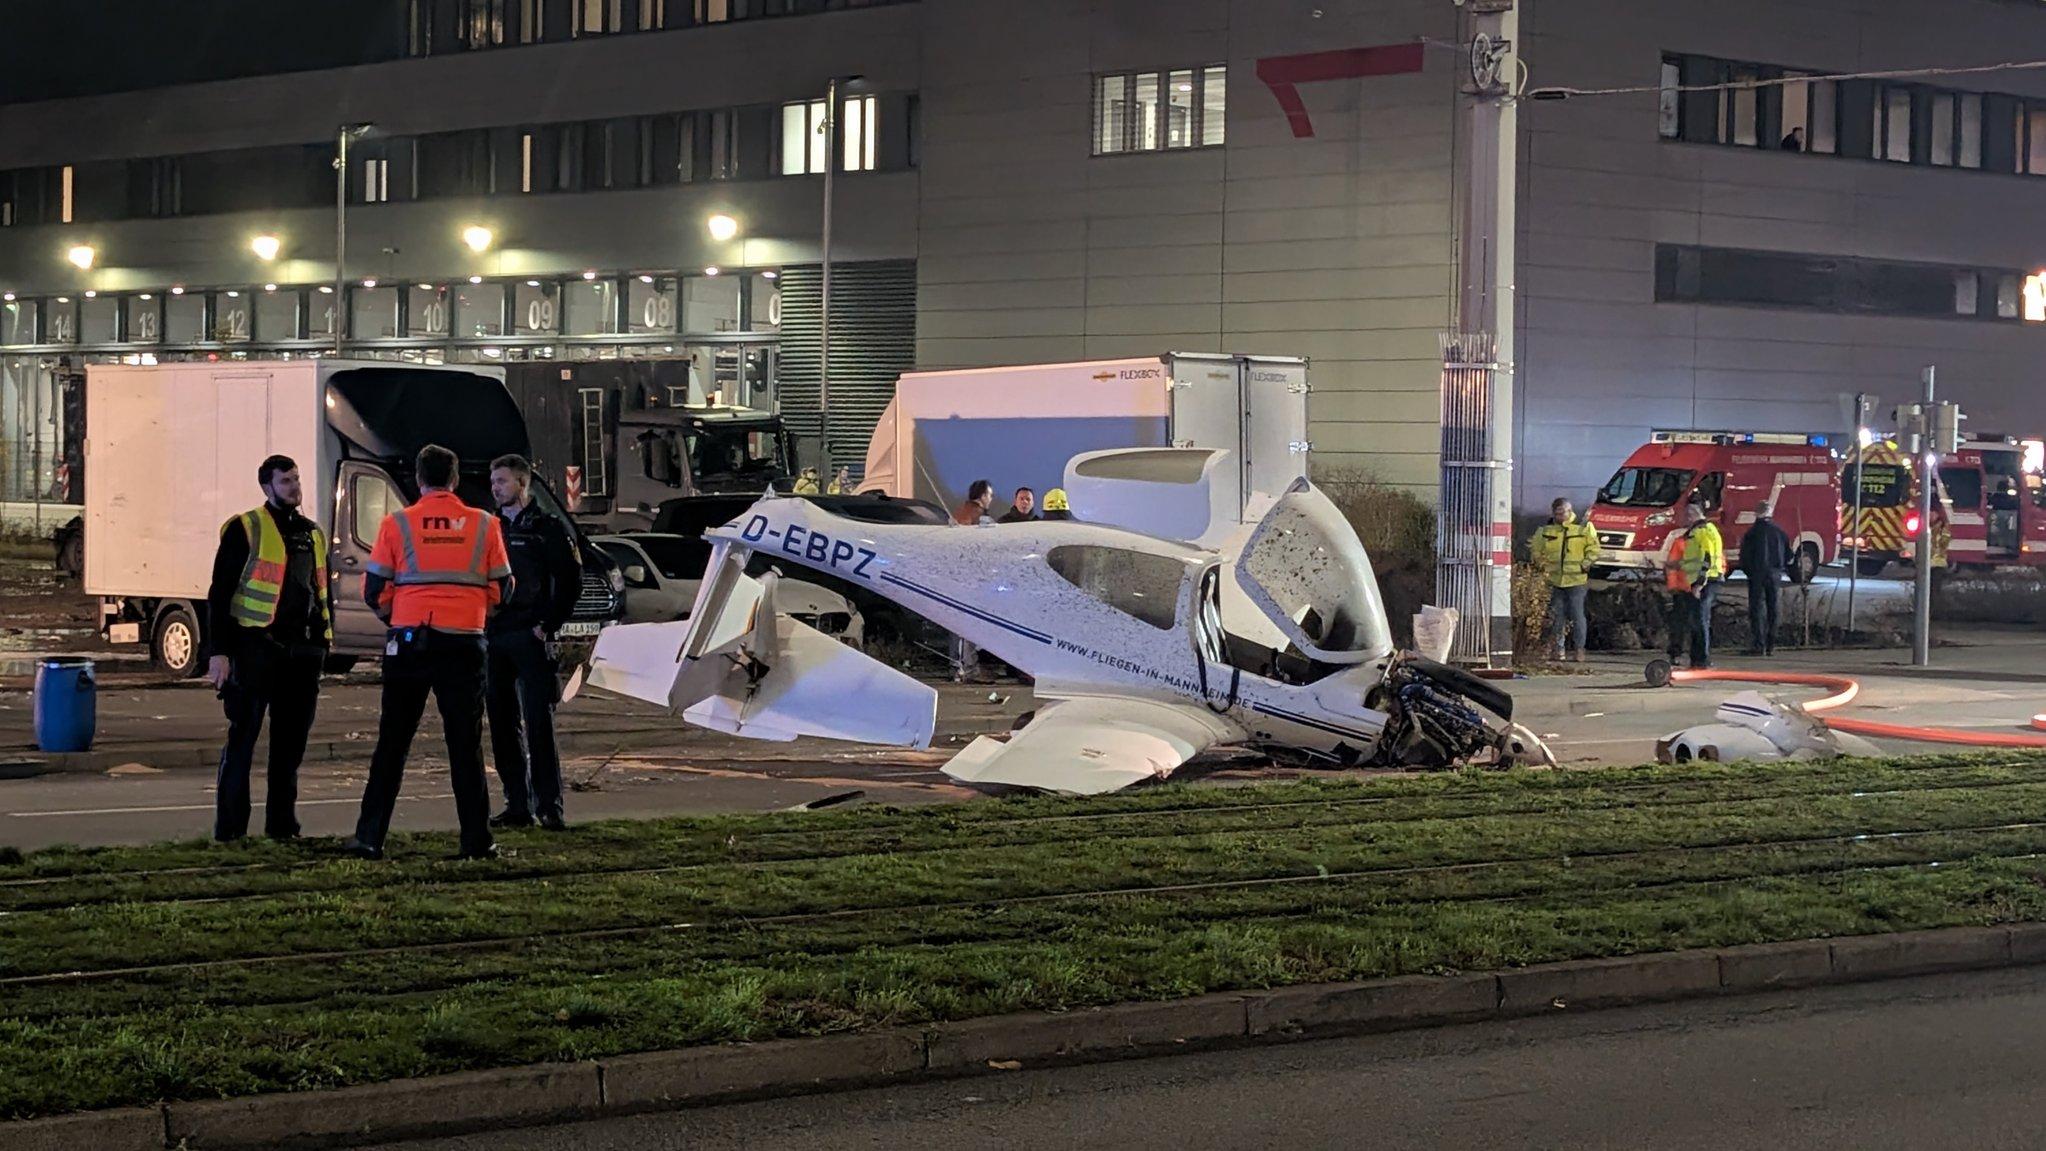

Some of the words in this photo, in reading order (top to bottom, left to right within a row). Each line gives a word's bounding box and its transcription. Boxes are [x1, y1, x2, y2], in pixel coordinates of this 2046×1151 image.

[227, 309, 245, 336] 12
[423, 303, 443, 332] 10
[528, 300, 552, 330] 09
[645, 297, 669, 328] 08
[769, 293, 782, 325] 0
[55, 314, 71, 340] 14
[139, 312, 155, 338] 13
[1120, 369, 1160, 380] FLEXBOX
[741, 514, 877, 580] D-EBPZ
